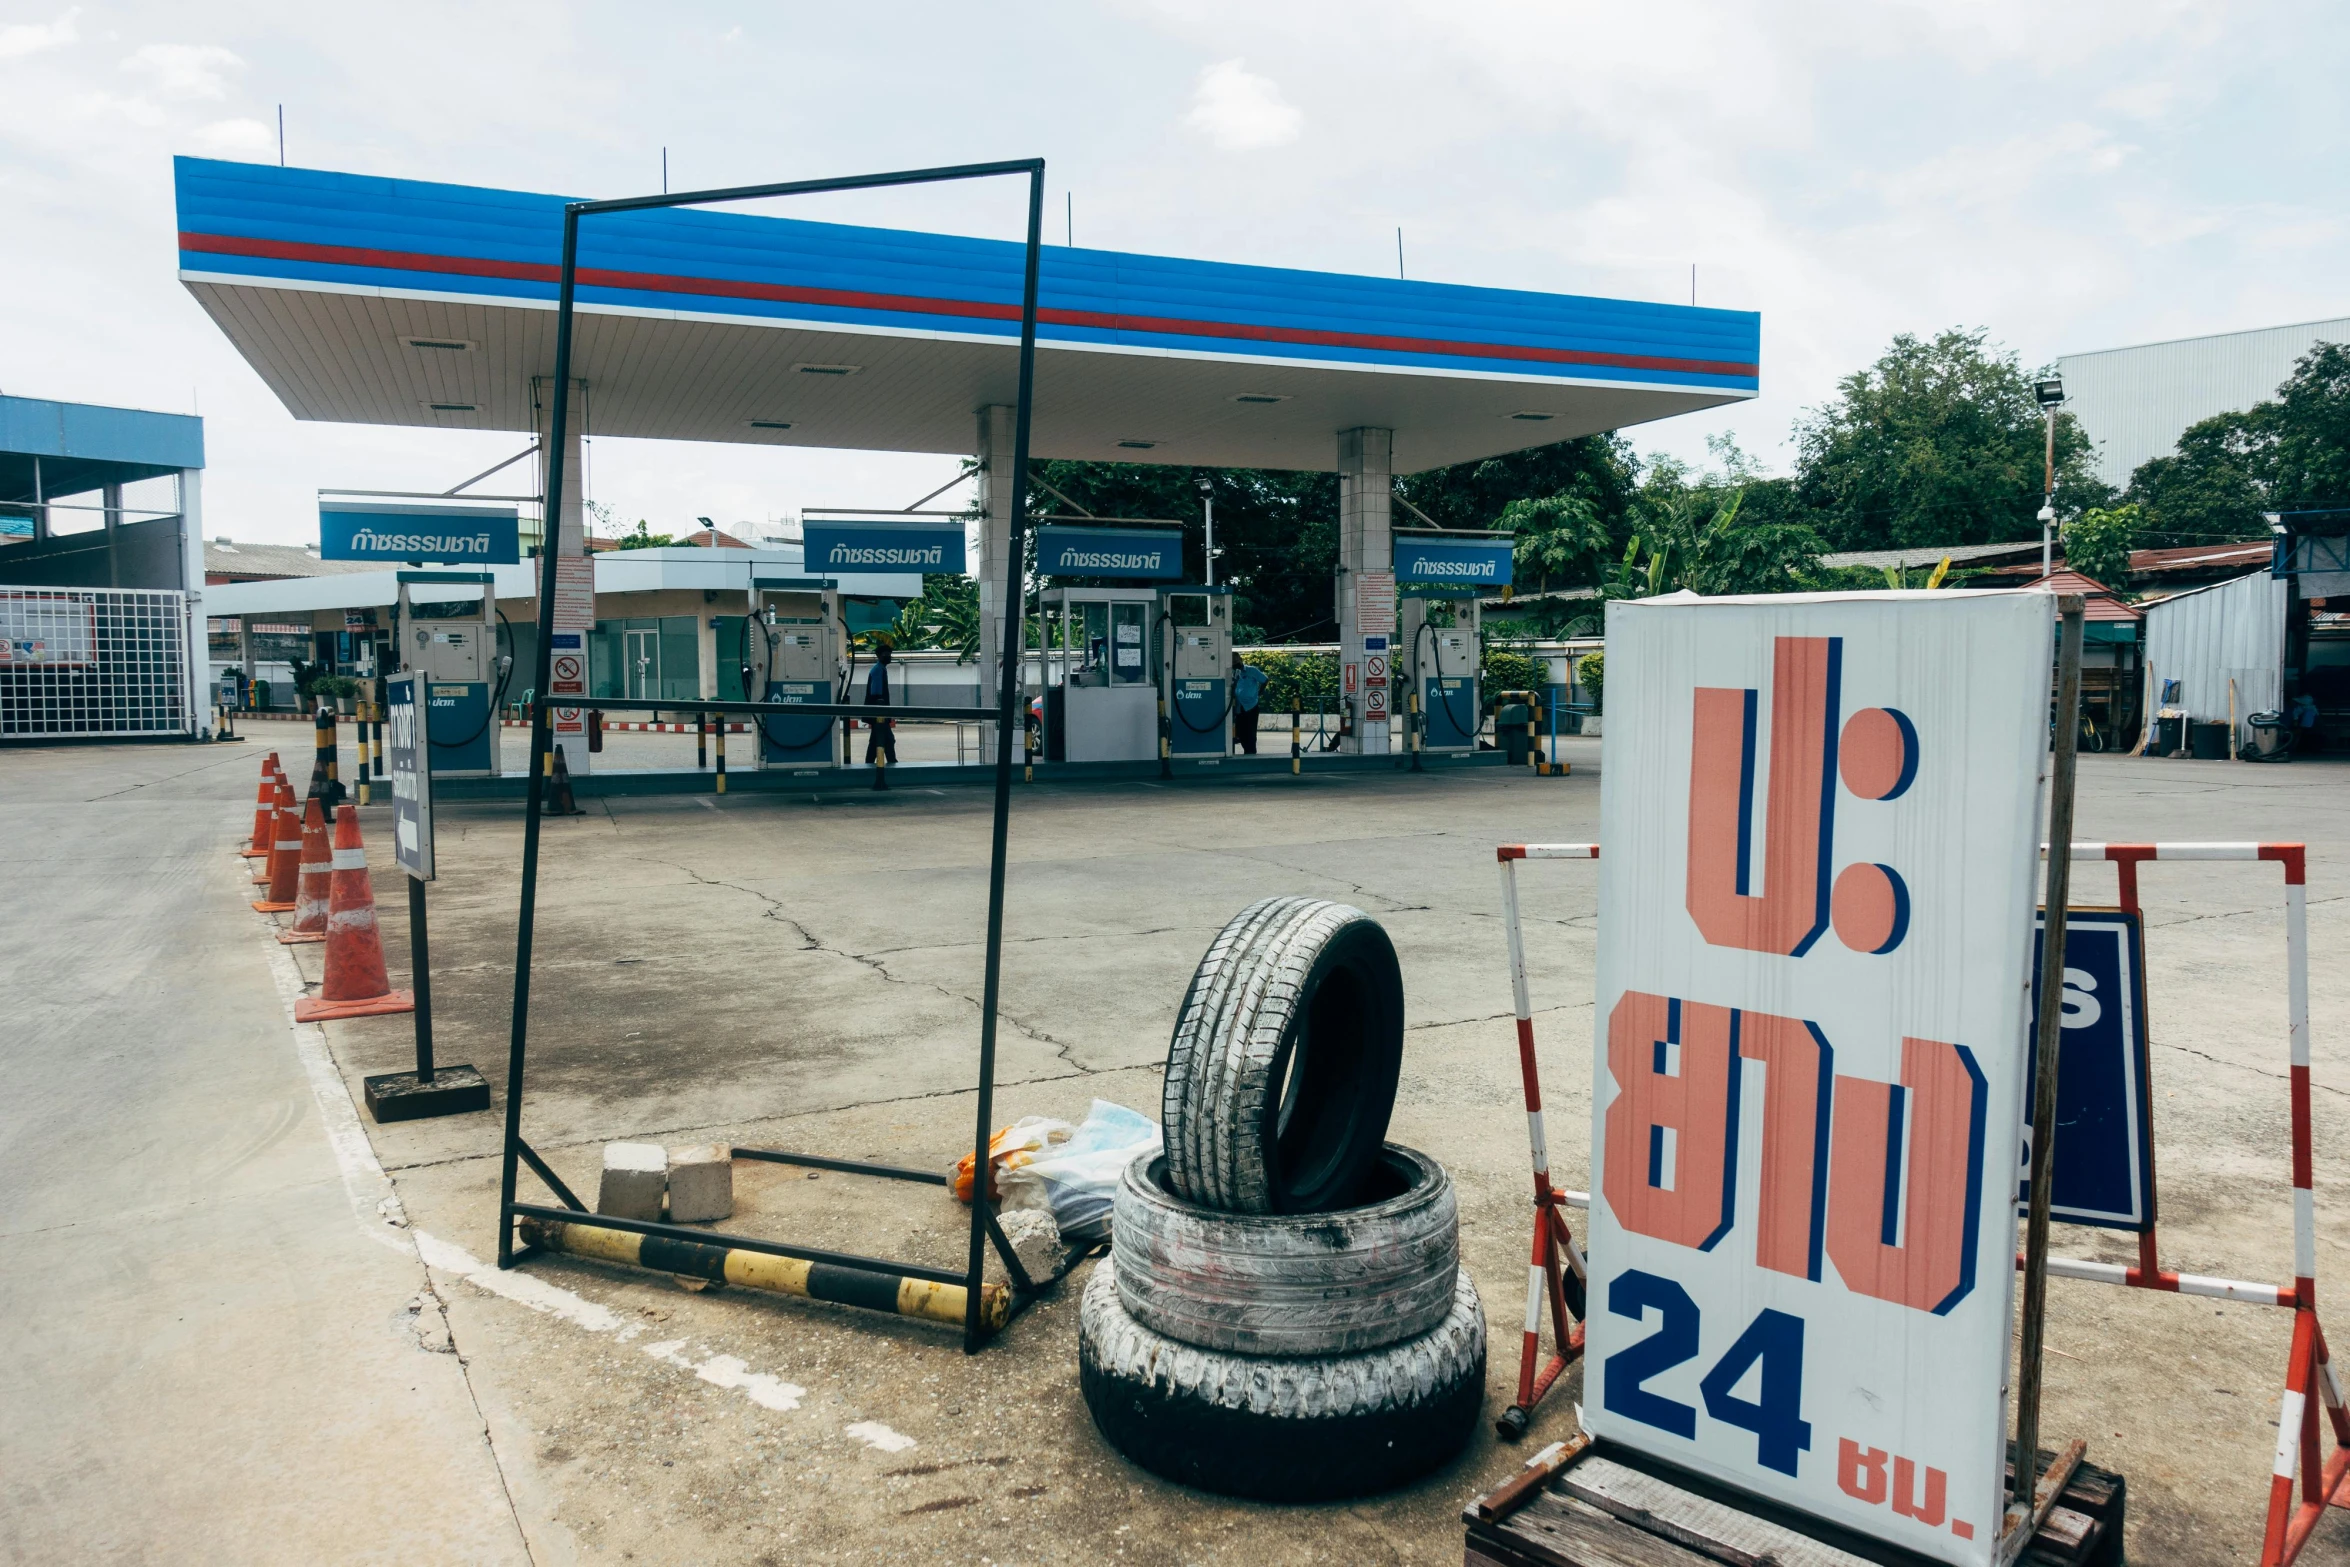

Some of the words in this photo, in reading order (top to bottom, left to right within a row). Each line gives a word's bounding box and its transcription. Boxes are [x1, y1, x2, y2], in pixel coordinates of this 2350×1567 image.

[351, 528, 490, 554] ก๊าซธรรมชาติ
[829, 543, 943, 565] ก๊าซธรรมชาติ
[1060, 547, 1161, 570] ก๊าซธรรมชาติ
[1412, 556, 1496, 577] ก๊าซธรรมชาติ
[1686, 636, 1920, 957] ปะ
[1602, 989, 1988, 1318] ยาง
[1603, 1268, 1812, 1479] 24
[1837, 1436, 1974, 1541] ชม.
